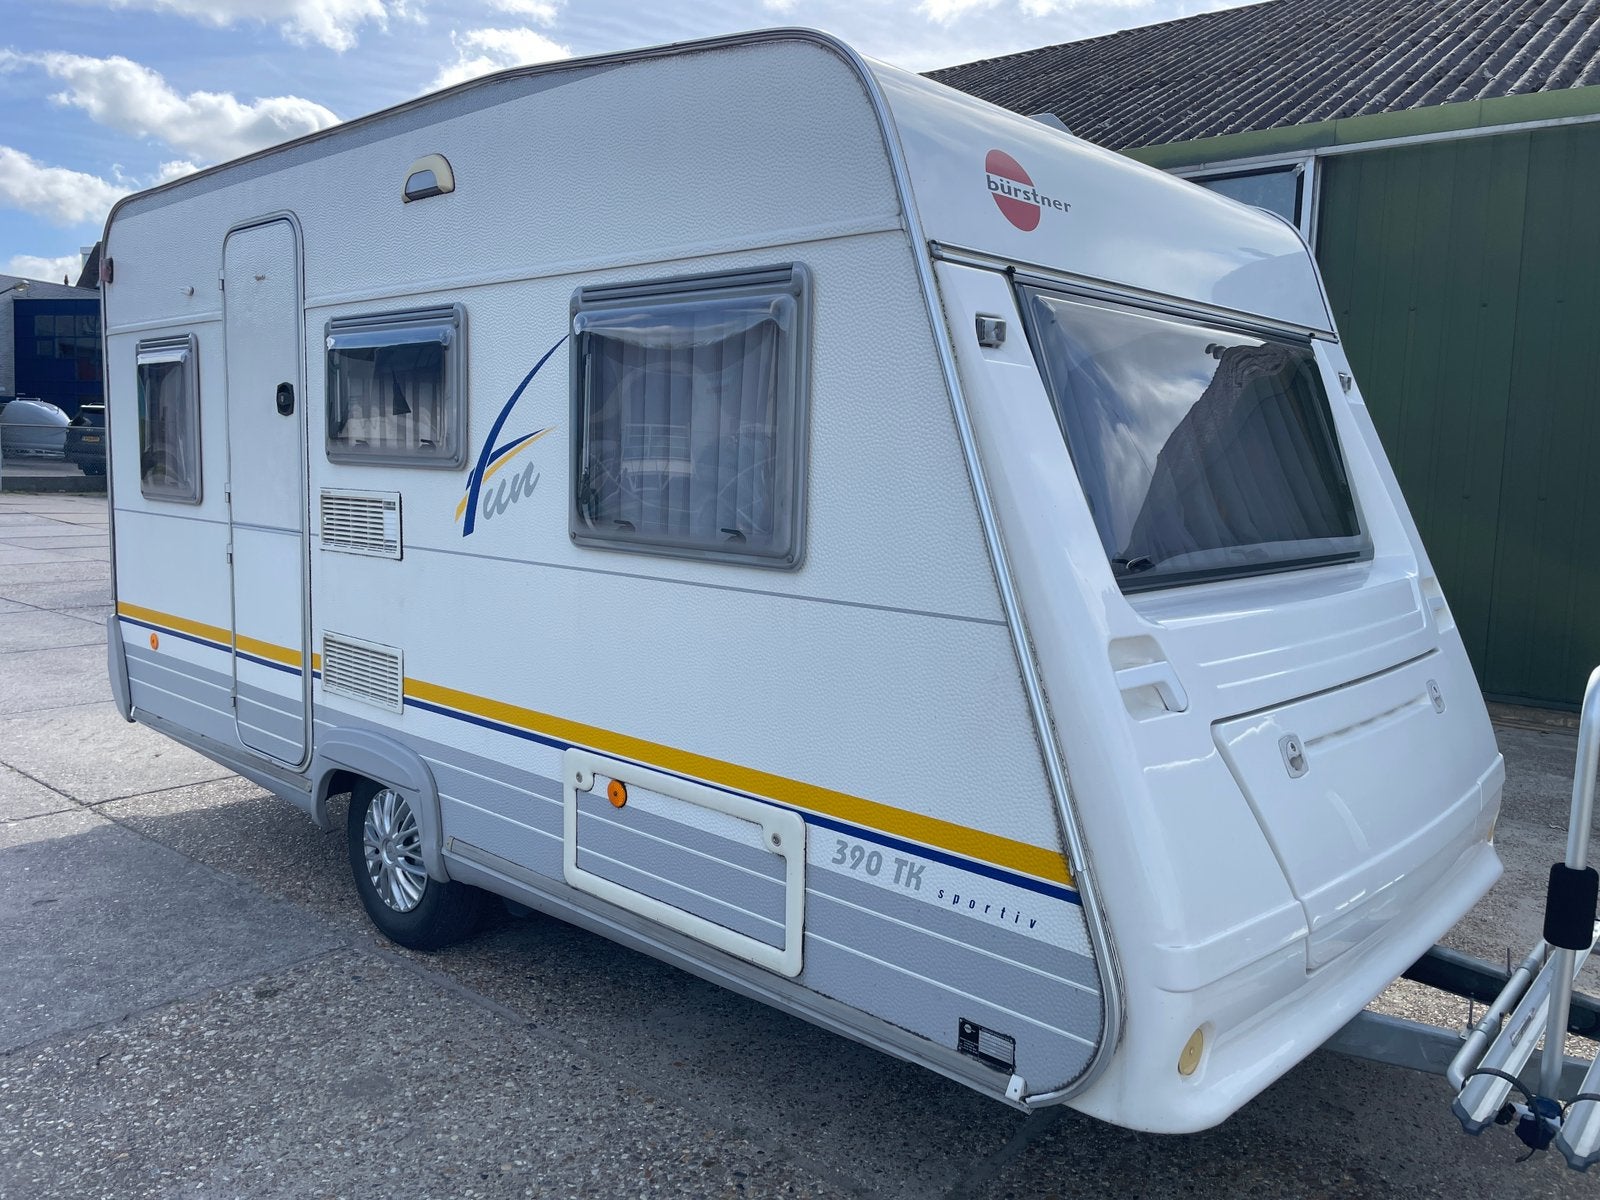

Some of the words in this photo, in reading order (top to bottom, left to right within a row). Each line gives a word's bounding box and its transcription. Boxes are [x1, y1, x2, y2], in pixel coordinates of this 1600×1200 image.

[986, 174, 1072, 213] bürstner
[454, 334, 570, 538] Fun
[831, 839, 883, 877] 390
[893, 857, 926, 892] TK
[937, 888, 1038, 929] sportiv
